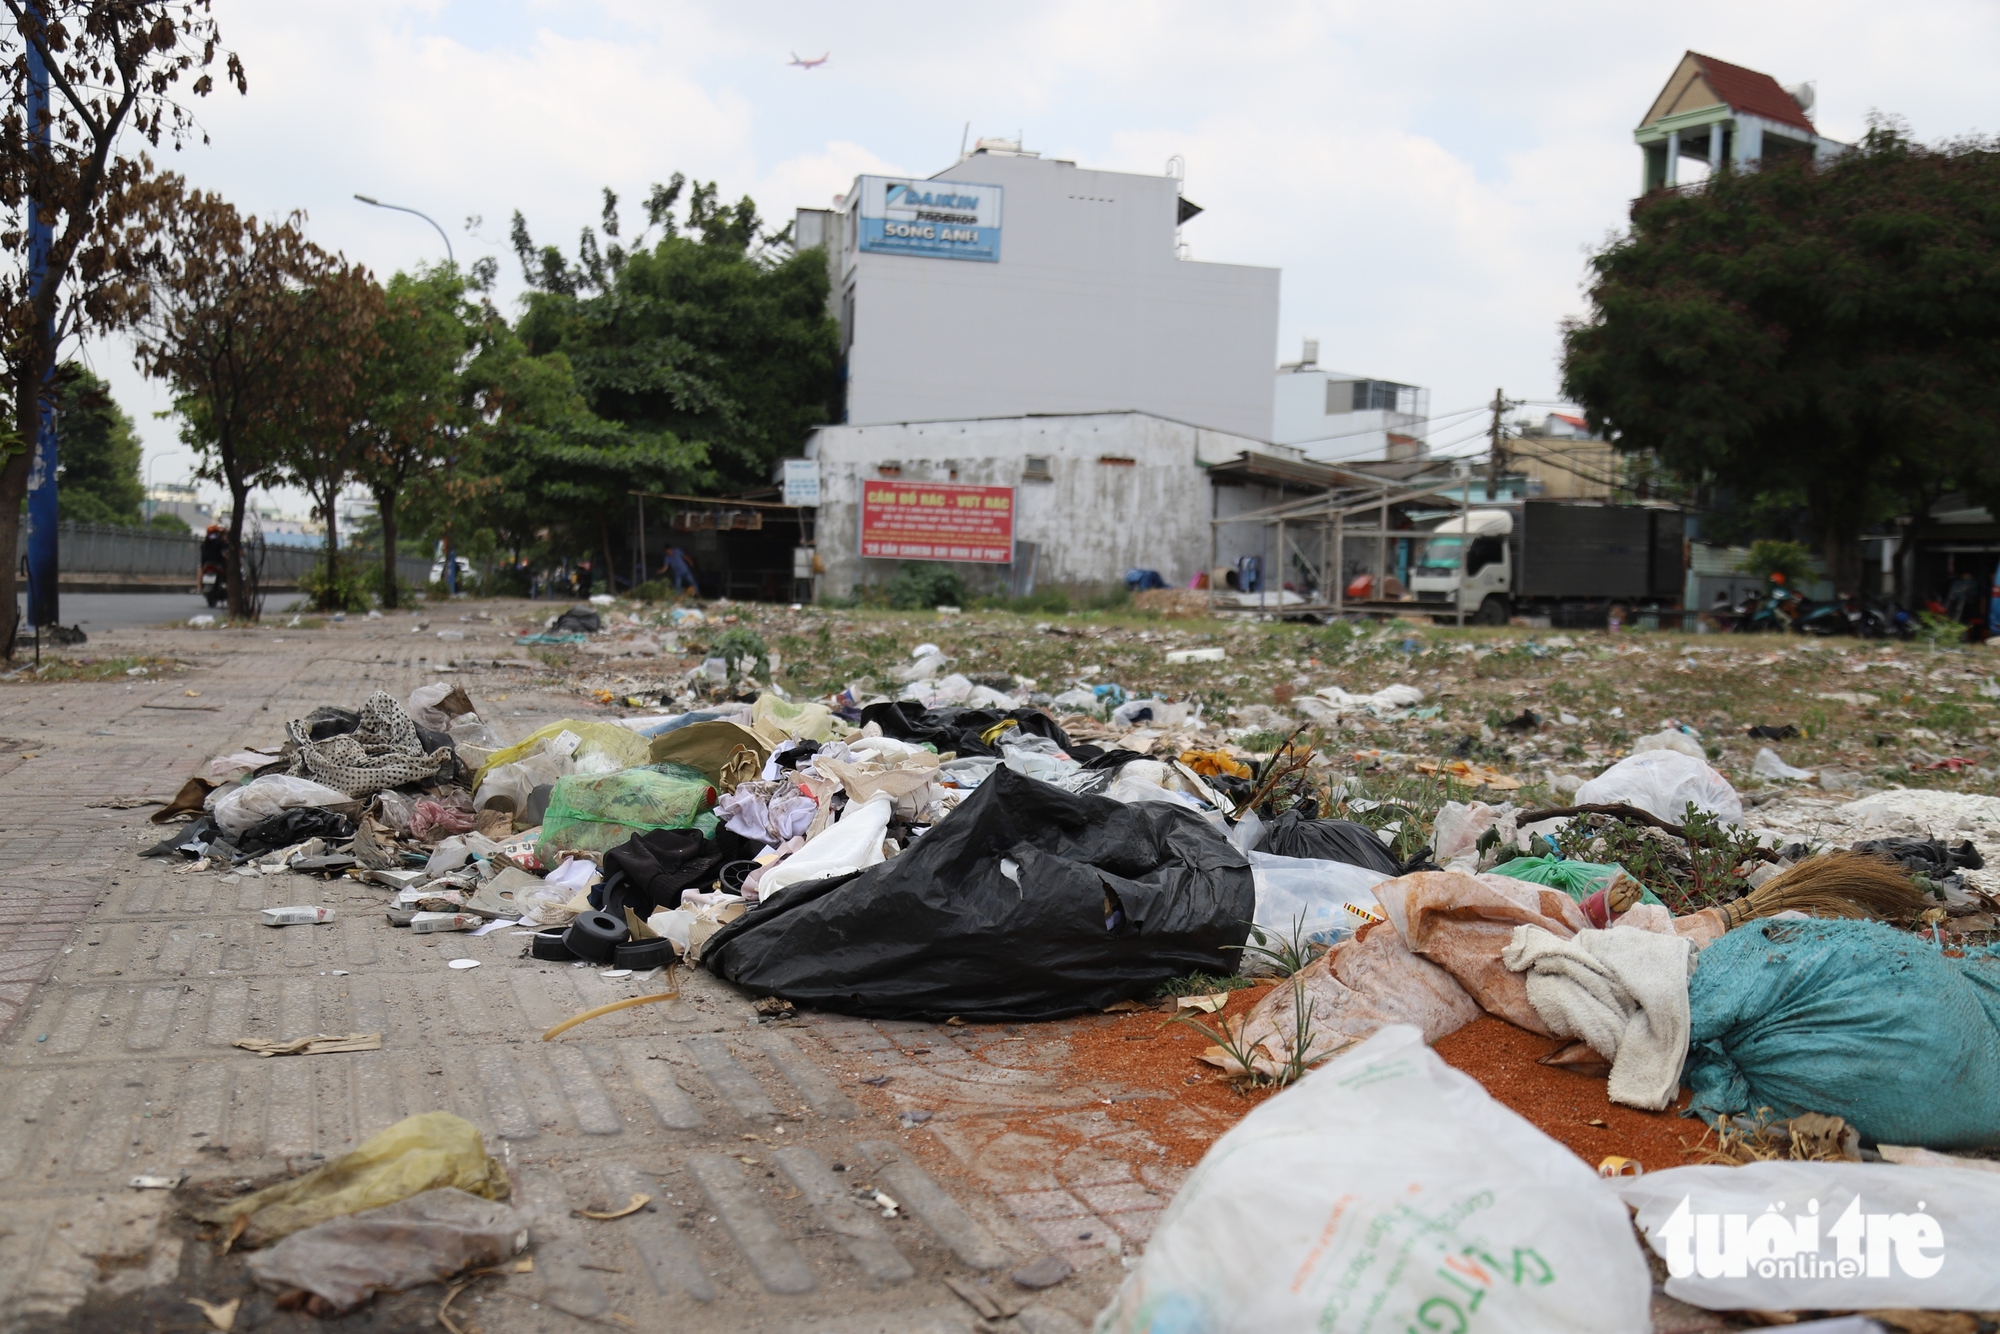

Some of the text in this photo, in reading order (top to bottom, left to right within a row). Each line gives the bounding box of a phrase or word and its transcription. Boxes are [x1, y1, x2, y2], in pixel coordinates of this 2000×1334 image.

[905, 190, 979, 210] DAIKIN
[884, 223, 979, 243] SONG ANH
